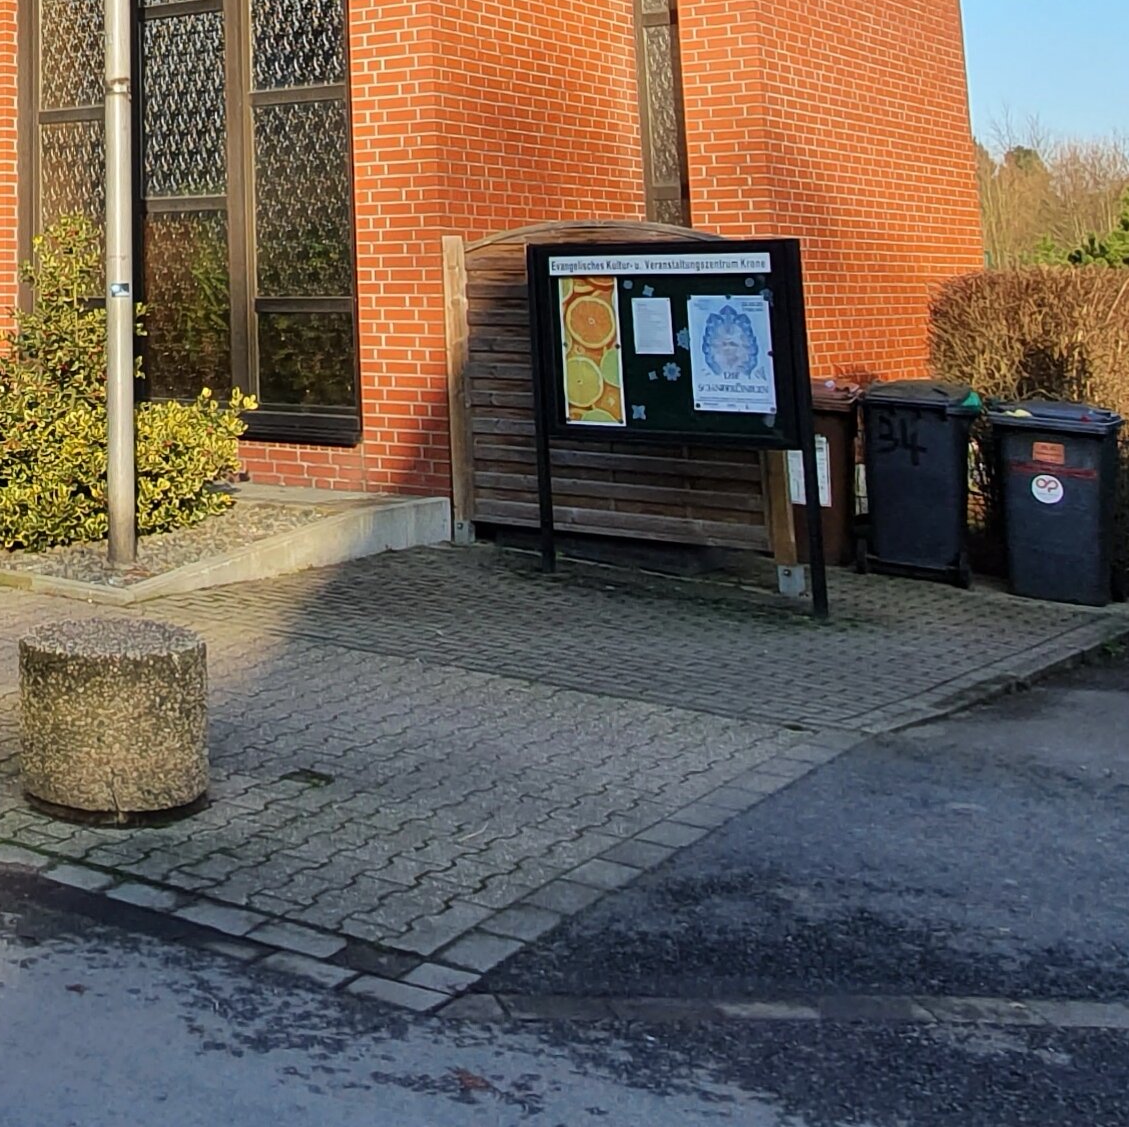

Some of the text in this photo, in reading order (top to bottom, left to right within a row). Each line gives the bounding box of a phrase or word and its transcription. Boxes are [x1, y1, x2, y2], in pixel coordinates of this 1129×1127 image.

[551, 260, 605, 272] Evangelisches
[606, 259, 633, 271] Kultur-
[644, 259, 739, 272] Veranstaltungszentrum
